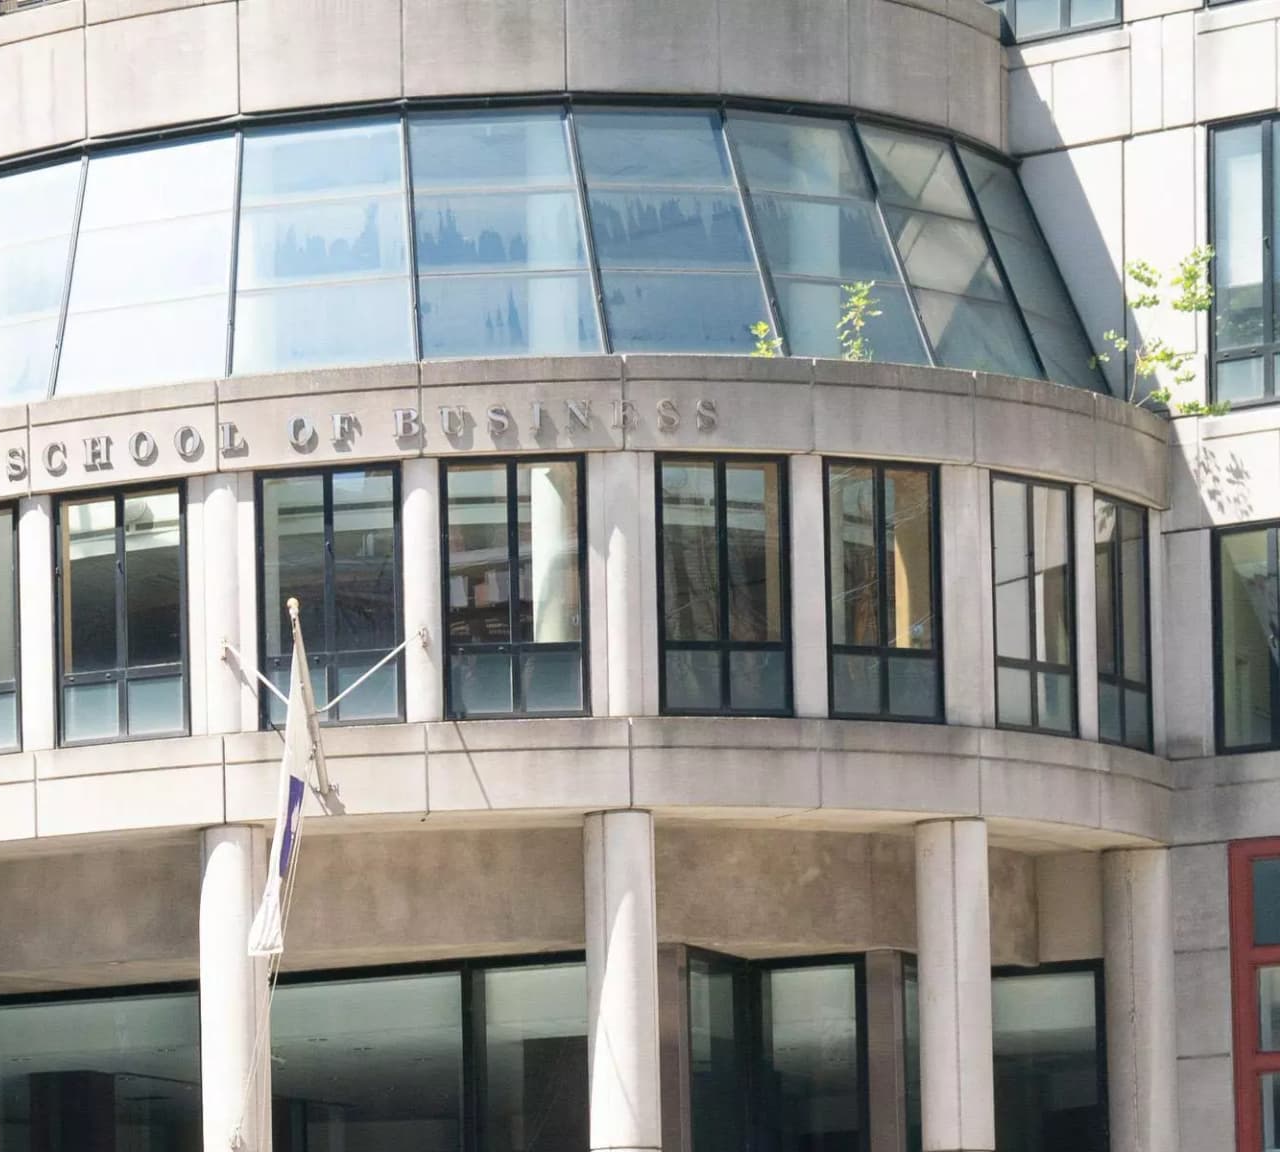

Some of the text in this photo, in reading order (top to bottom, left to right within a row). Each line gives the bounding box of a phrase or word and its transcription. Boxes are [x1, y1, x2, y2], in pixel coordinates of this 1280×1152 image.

[6, 421, 248, 482] SCHOOL
[286, 411, 361, 455] OF
[391, 398, 722, 446] BUSINESS
